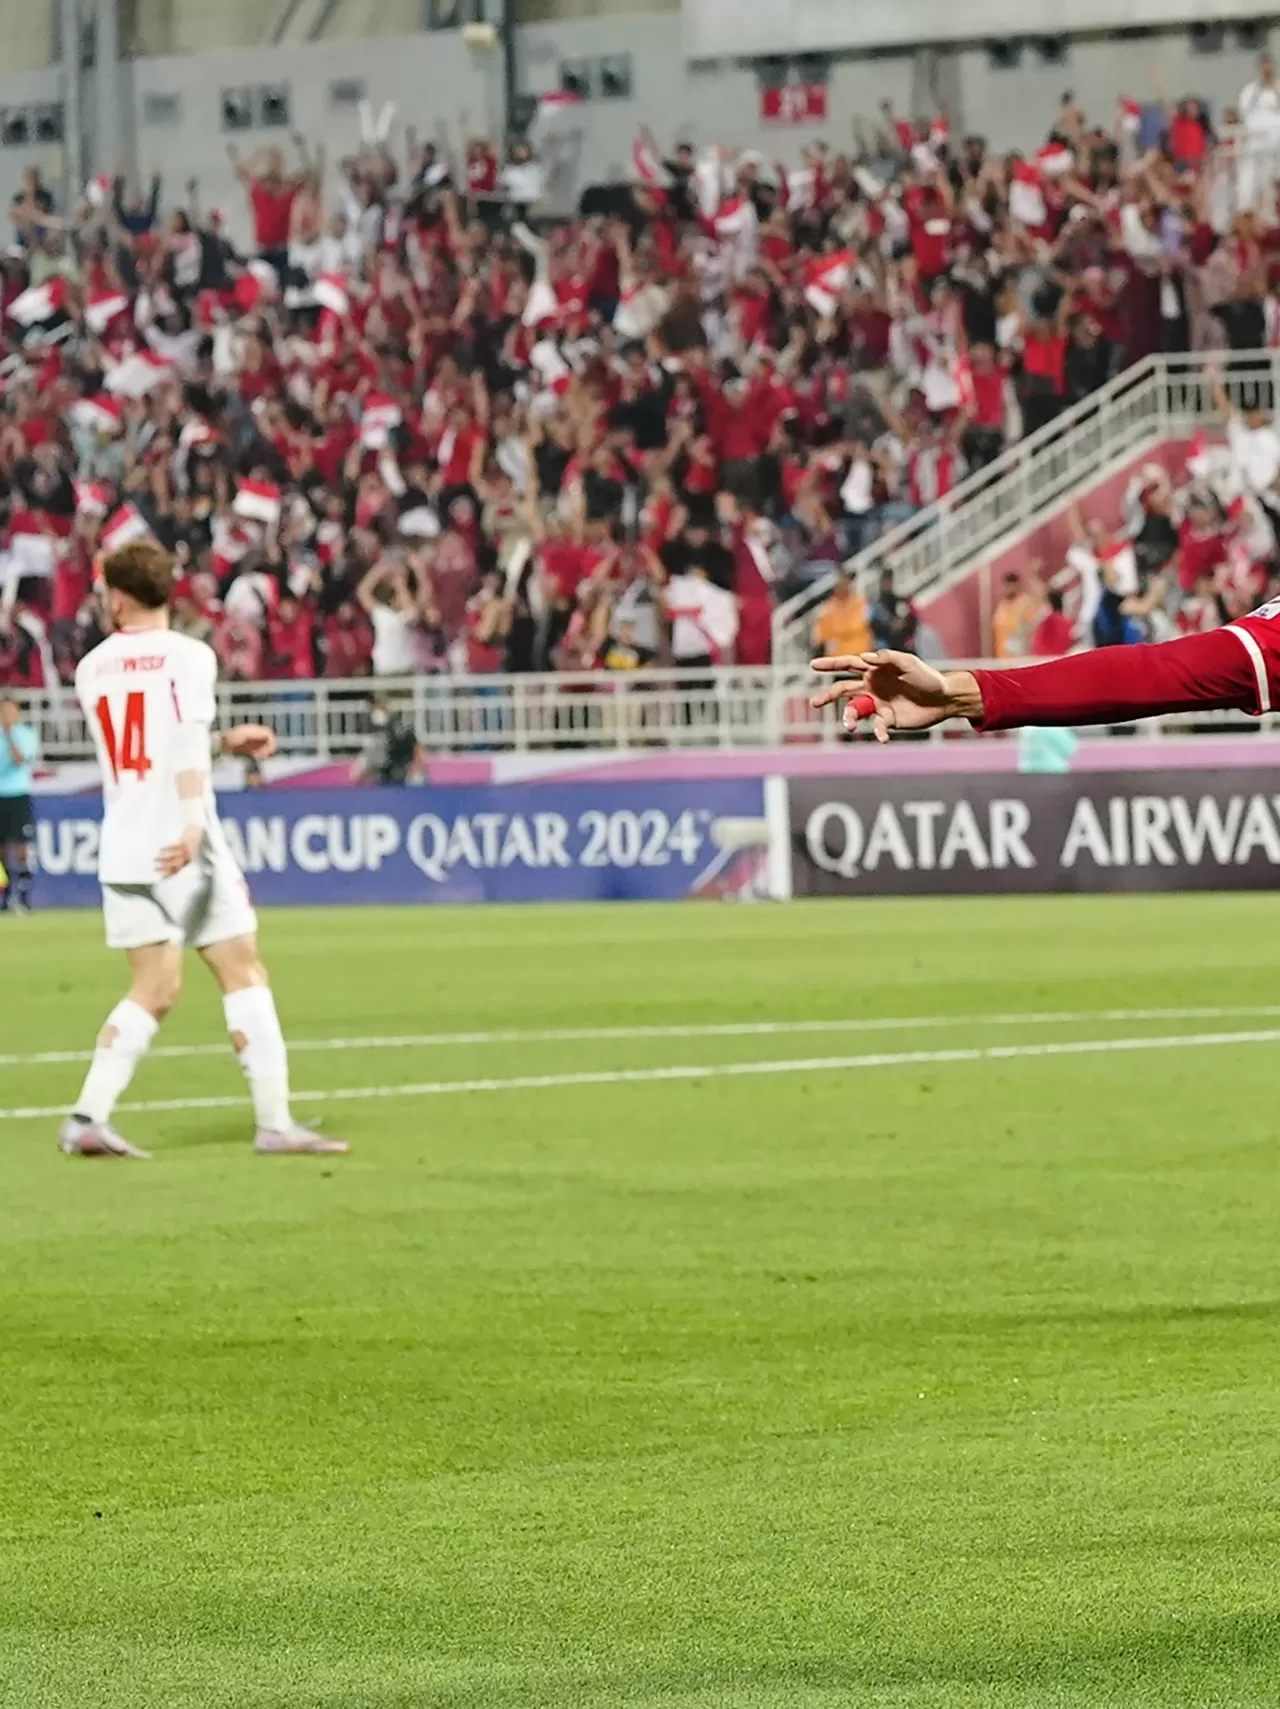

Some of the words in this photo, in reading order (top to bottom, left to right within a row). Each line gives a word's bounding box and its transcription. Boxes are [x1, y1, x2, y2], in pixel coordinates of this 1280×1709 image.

[95, 692, 153, 784] 14
[36, 818, 101, 875] U2
[290, 814, 400, 873] CUP
[406, 812, 570, 883] QATAR
[577, 809, 699, 869] 2024
[806, 801, 1036, 878] QATAR
